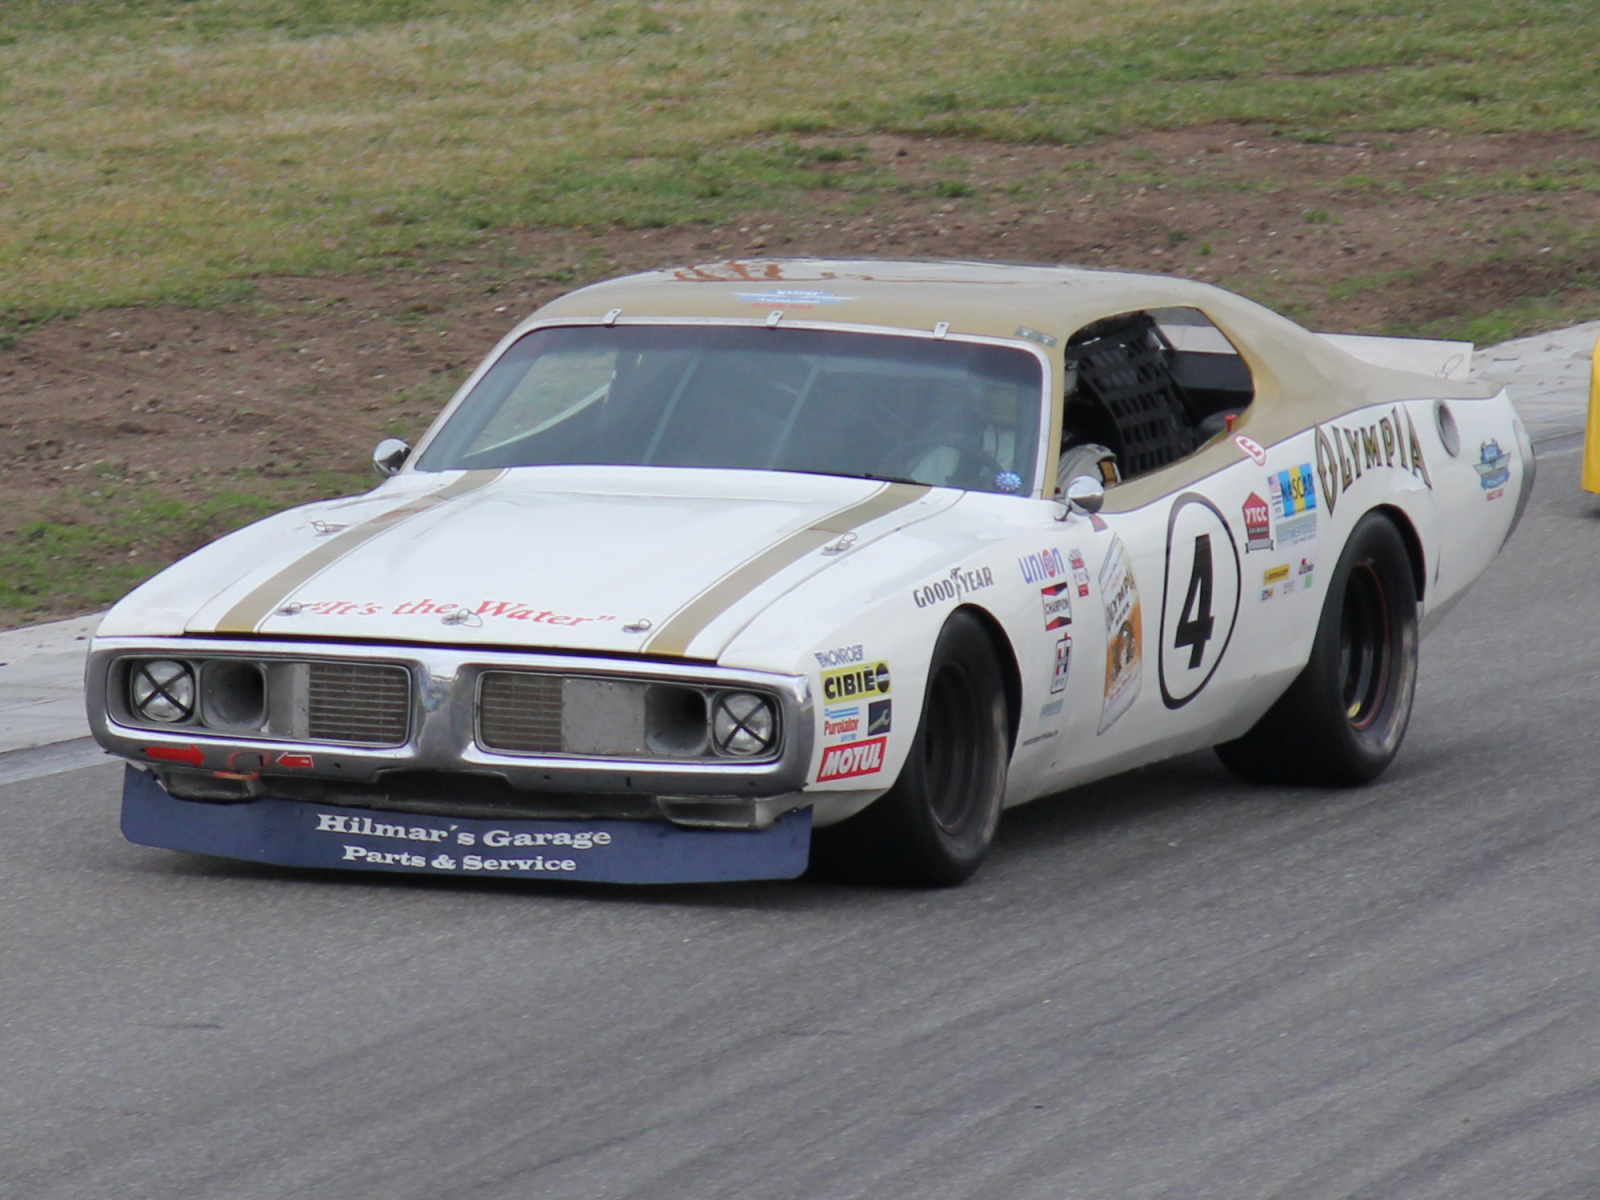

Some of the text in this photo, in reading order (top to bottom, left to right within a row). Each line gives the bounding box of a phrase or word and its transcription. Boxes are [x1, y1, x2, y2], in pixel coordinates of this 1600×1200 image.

[1314, 403, 1433, 518] OLYMPIA
[1280, 473, 1315, 503] NASCAR
[1245, 506, 1267, 524] YTCC
[391, 599, 459, 615] the
[1045, 598, 1069, 615] CHAMPION
[1174, 533, 1215, 670] 4
[824, 718, 859, 736] Purolator
[820, 742, 882, 778] MOTUL
[483, 829, 612, 849] Garage
[342, 845, 577, 871] Parts & Service
